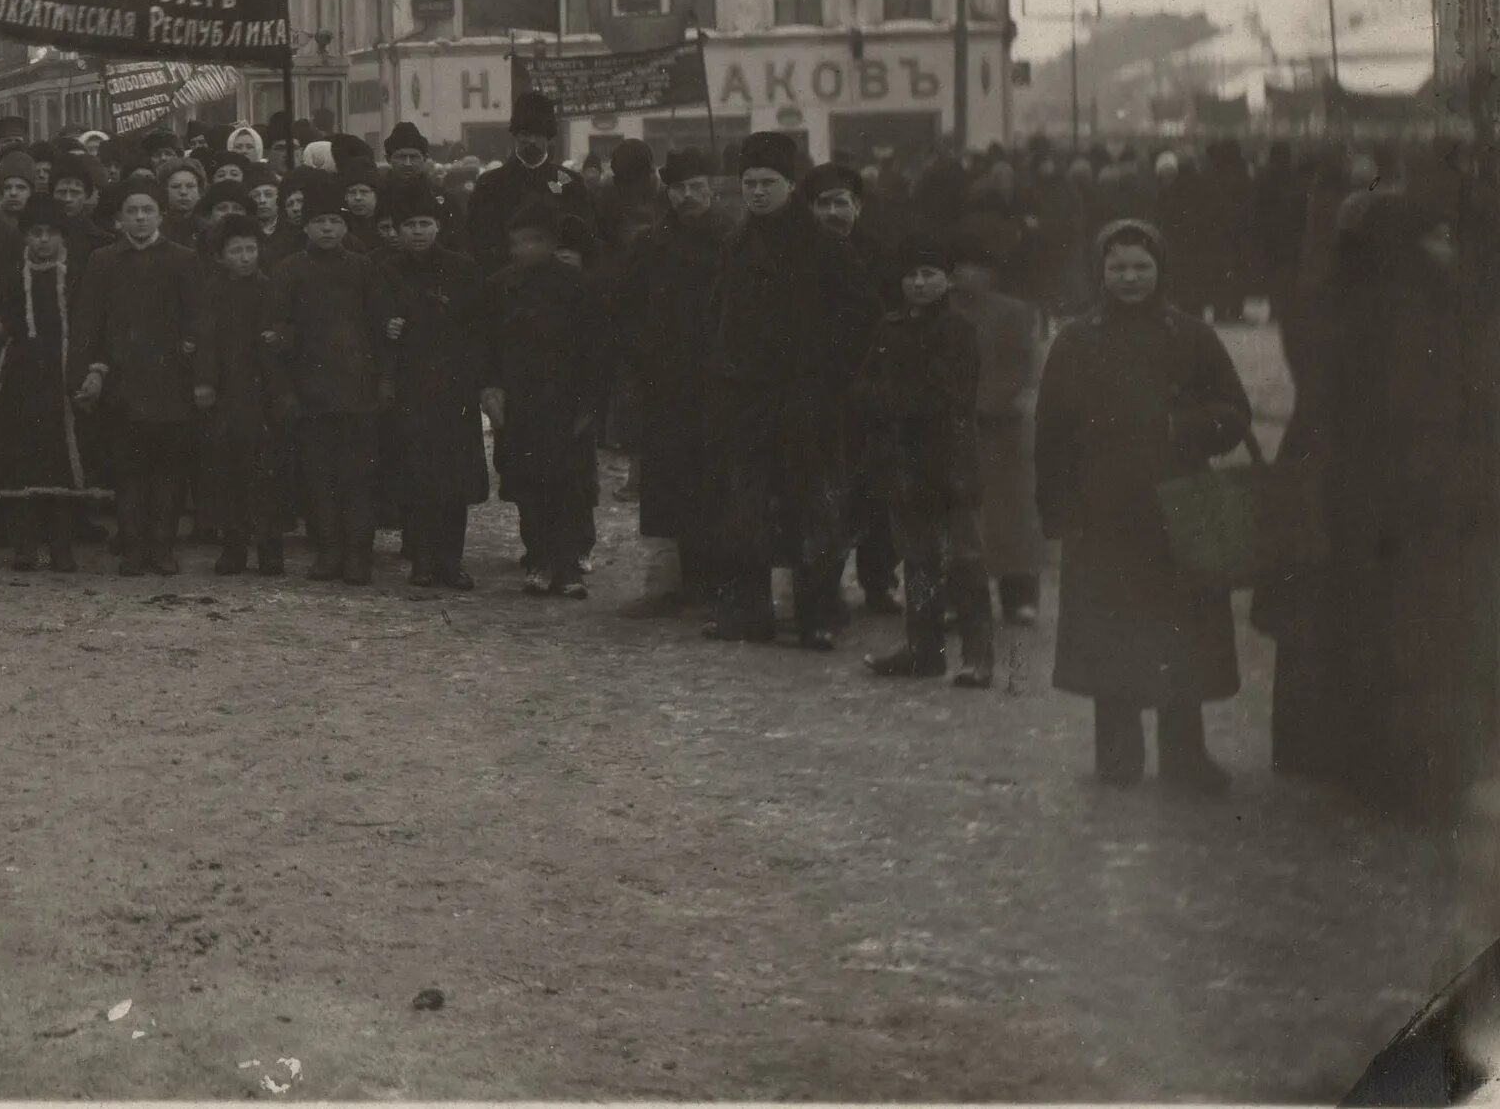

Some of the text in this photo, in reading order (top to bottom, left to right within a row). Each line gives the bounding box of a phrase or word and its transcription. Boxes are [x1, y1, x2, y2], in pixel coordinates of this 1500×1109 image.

[148, 5, 288, 48] РЕСПУБЛИКА
[460, 69, 499, 110] Н.
[719, 56, 941, 103] АКОВЪ
